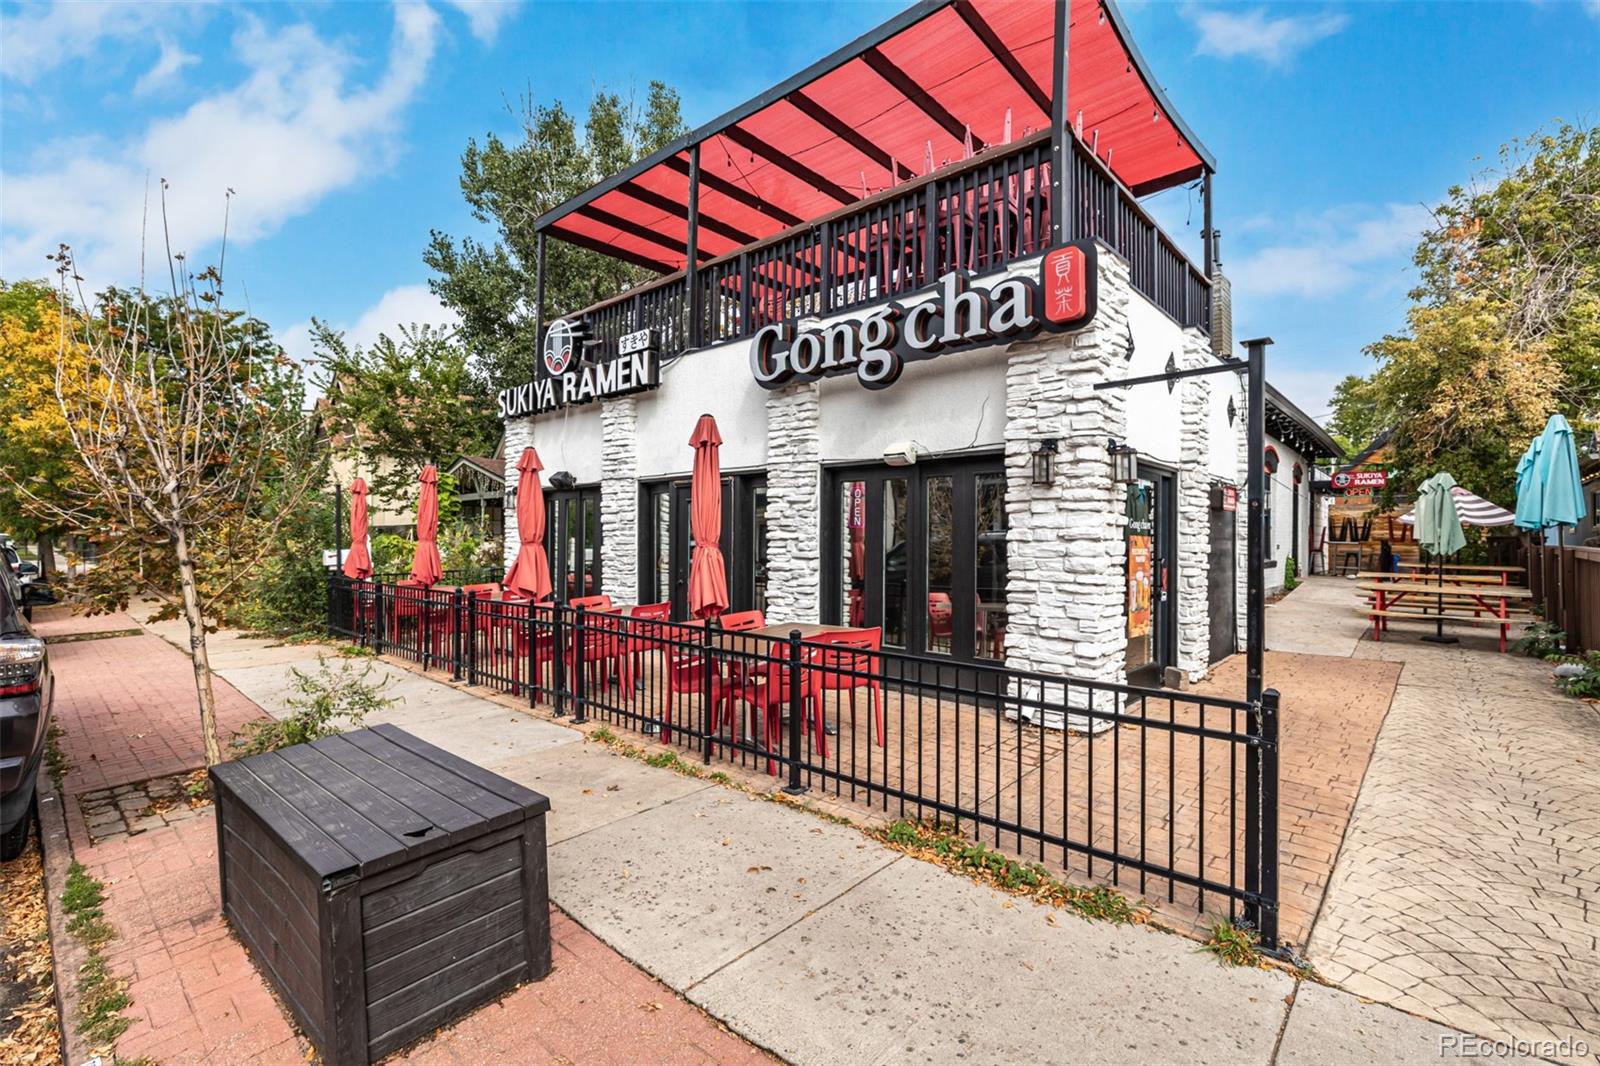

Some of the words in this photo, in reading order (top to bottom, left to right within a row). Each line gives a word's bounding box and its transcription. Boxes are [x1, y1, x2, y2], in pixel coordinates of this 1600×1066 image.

[620, 331, 649, 353] すきや
[750, 306, 894, 382] Gong
[903, 271, 1034, 350] cha
[497, 377, 556, 418] SUKIYA
[562, 350, 650, 403] RAMEN
[854, 488, 862, 526] OPEN
[1345, 488, 1372, 496] OPEN
